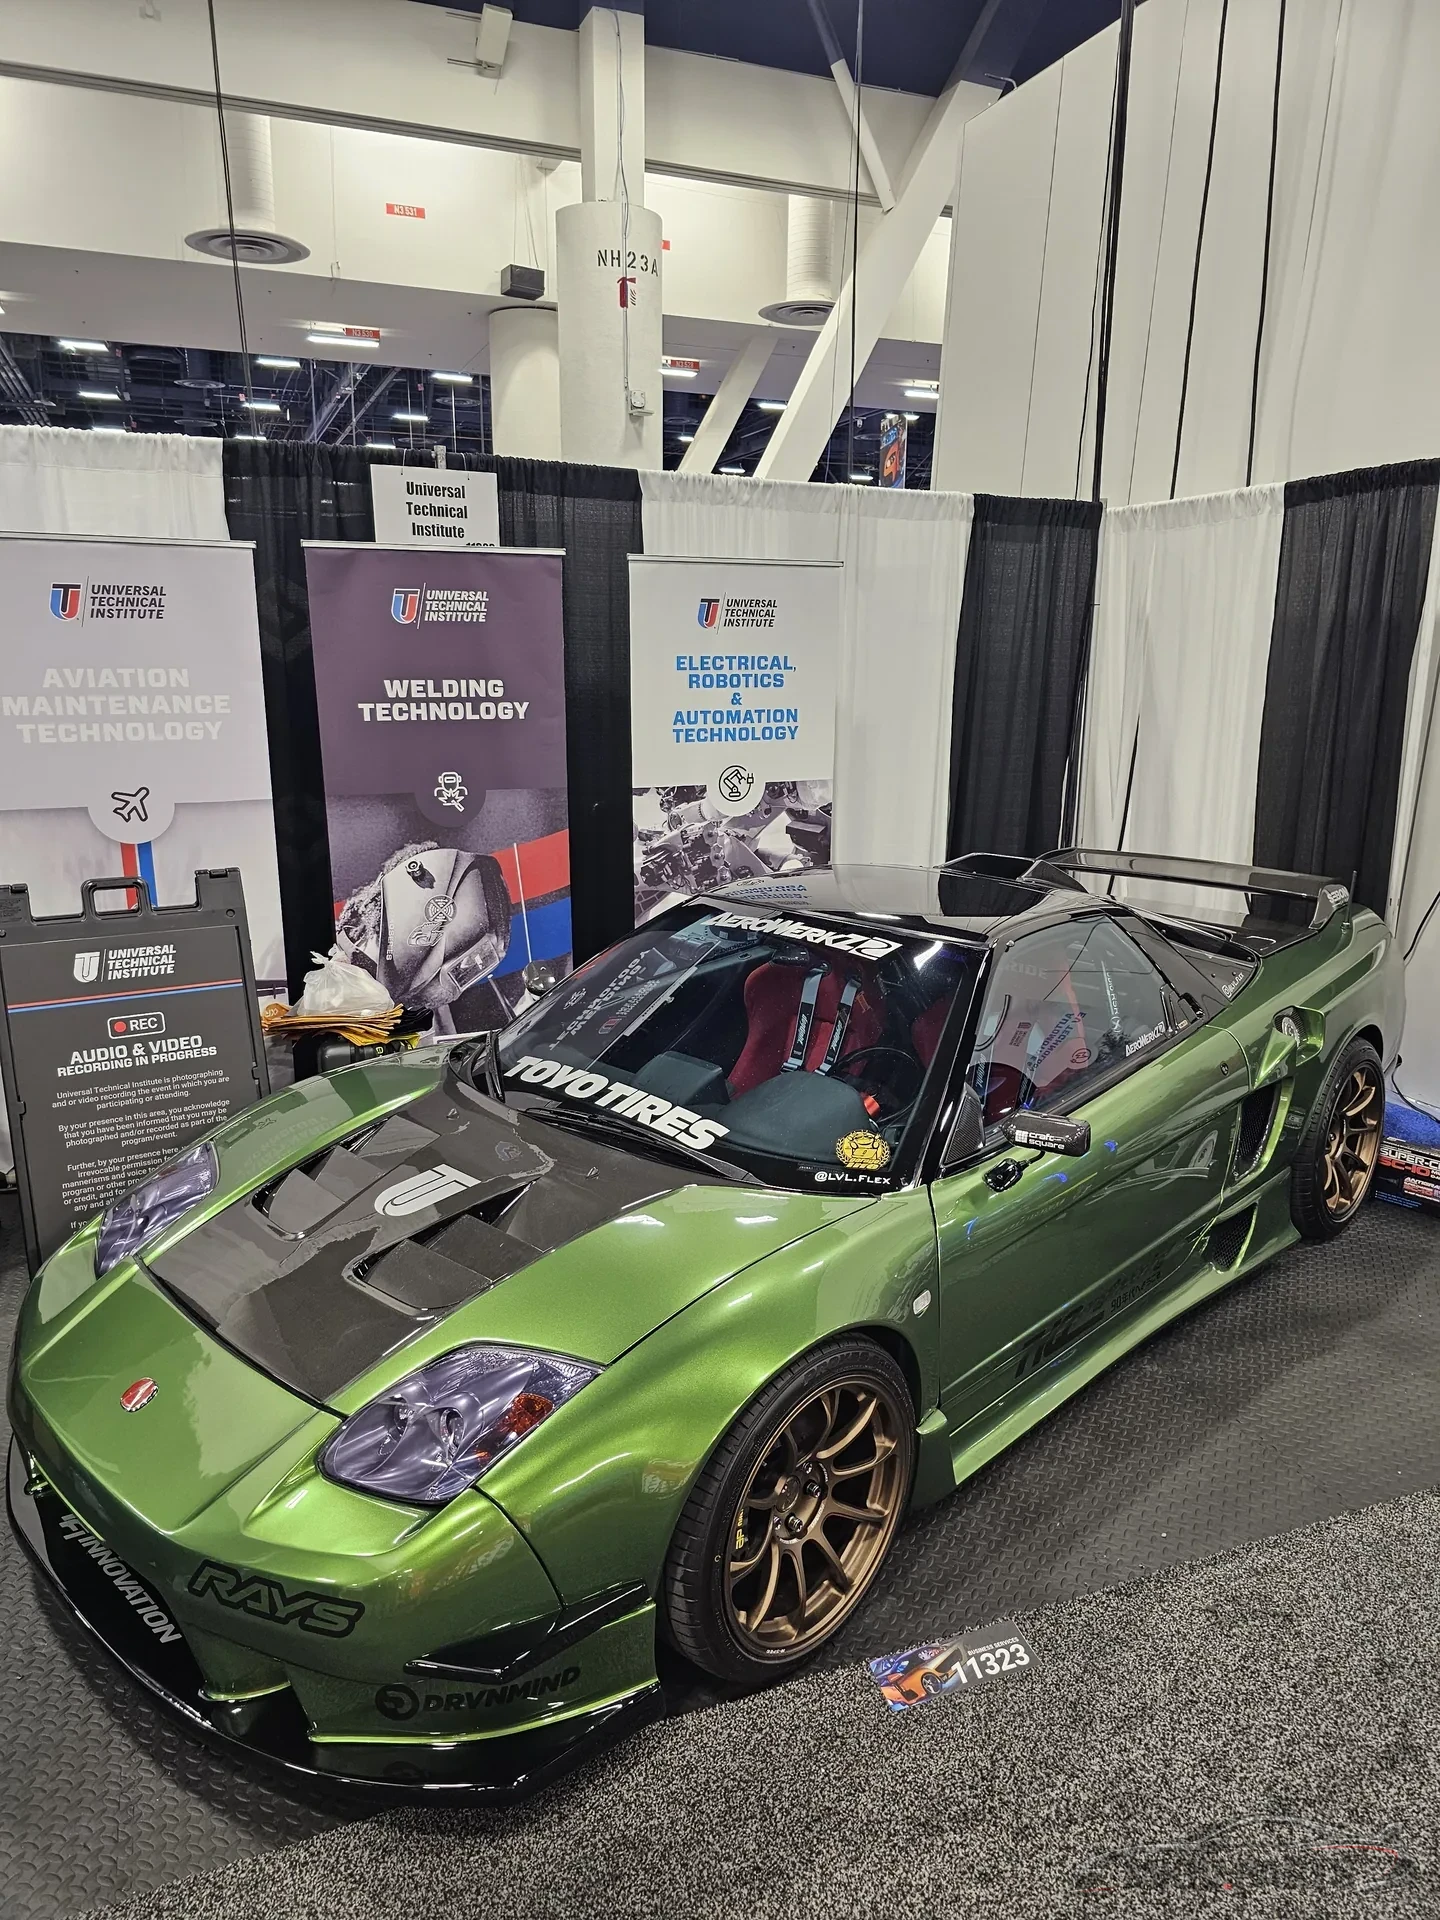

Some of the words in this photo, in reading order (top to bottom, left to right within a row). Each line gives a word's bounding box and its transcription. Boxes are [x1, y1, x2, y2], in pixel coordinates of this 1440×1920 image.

[406, 481, 466, 499] Universal
[406, 502, 468, 519] Technical
[412, 522, 465, 539] Institute
[91, 584, 167, 597] UNIVERSAL
[426, 590, 490, 602] UNIVERSAL
[90, 596, 166, 608] TECHNICAL
[425, 600, 488, 612] TECHNICAL
[726, 598, 778, 608] UNIVERSAL
[90, 608, 165, 620] INSTITUTE
[424, 612, 487, 622] INSTITUTE
[724, 608, 776, 618] TECHNICAL
[723, 618, 774, 628] INSTITUTE
[676, 655, 797, 672] ELECTRICAL,
[42, 667, 190, 688] AVIATION
[688, 674, 785, 688] ROBOTICS
[383, 680, 505, 698] WELDING
[1, 694, 232, 716] MAINTENANCE
[731, 692, 742, 706] &
[357, 702, 530, 722] TECHNOLOGY
[673, 708, 798, 726] AUTOMATION
[16, 720, 224, 744] TECHNOLOGY
[672, 726, 799, 744] TECHNOLOGY
[108, 944, 177, 960] UNIVERSAL
[108, 954, 176, 970] TECHNICAL
[108, 964, 174, 980] INSTITUTE
[130, 1018, 158, 1032] REC
[70, 1045, 128, 1065] AUDIO
[132, 1043, 146, 1056] &
[149, 1035, 203, 1054] VIDEO
[57, 1057, 133, 1077] RECORDING
[136, 1056, 149, 1066] IN
[151, 1046, 218, 1064] PROGRESS
[56, 1088, 92, 1099] Universal
[94, 1082, 130, 1094] Technical
[132, 1078, 162, 1088] Institute
[172, 1070, 224, 1083] photographing
[52, 1100, 66, 1108] and
[78, 1096, 99, 1104] video
[100, 1090, 136, 1100] recording
[138, 1088, 150, 1096] the
[181, 1080, 202, 1088] which
[96, 1097, 144, 1111] participating
[154, 1090, 191, 1100] attending.
[504, 1056, 609, 1098] TOYO
[594, 1082, 731, 1150] TIRES
[70, 1122, 88, 1131] your
[88, 1116, 124, 1128] presence
[134, 1112, 148, 1120] this
[150, 1110, 168, 1118] area,
[168, 1107, 182, 1116] you
[184, 1100, 230, 1112] acknowledge
[66, 1132, 118, 1148] photographed
[120, 1128, 144, 1138] and/or
[146, 1122, 179, 1134] recorded
[190, 1118, 206, 1128] part
[80, 1129, 95, 1138] you
[96, 1126, 114, 1134] have
[136, 1117, 170, 1127] informed
[170, 1114, 186, 1122] that
[186, 1112, 200, 1120] you
[122, 1131, 178, 1148] program/event.
[1028, 1138, 1065, 1150] square
[67, 1162, 97, 1172] Further,
[98, 1159, 107, 1167] by
[108, 1156, 126, 1165] your
[127, 1150, 161, 1163] presence
[78, 1164, 120, 1178] irrevocable
[122, 1158, 162, 1172] permission
[1380, 1148, 1440, 1171] SUPER-C
[62, 1176, 110, 1189] mannerisms
[111, 1172, 126, 1180] and
[126, 1168, 146, 1178] voice
[814, 1171, 892, 1185] @LVL.FLEX
[62, 1185, 98, 1198] program
[106, 1181, 126, 1190] other
[64, 1198, 72, 1206] or
[74, 1194, 98, 1204] credit,
[100, 1191, 114, 1199] and
[74, 1204, 88, 1212] any
[90, 1200, 104, 1208] and
[70, 1220, 76, 1228] If
[188, 1559, 366, 1638] RAYS
[967, 1644, 995, 1656] BUSINESS
[994, 1636, 1020, 1650] SERVICES
[950, 1644, 1030, 1684] 11323
[423, 1666, 581, 1712] DRVNMIND
